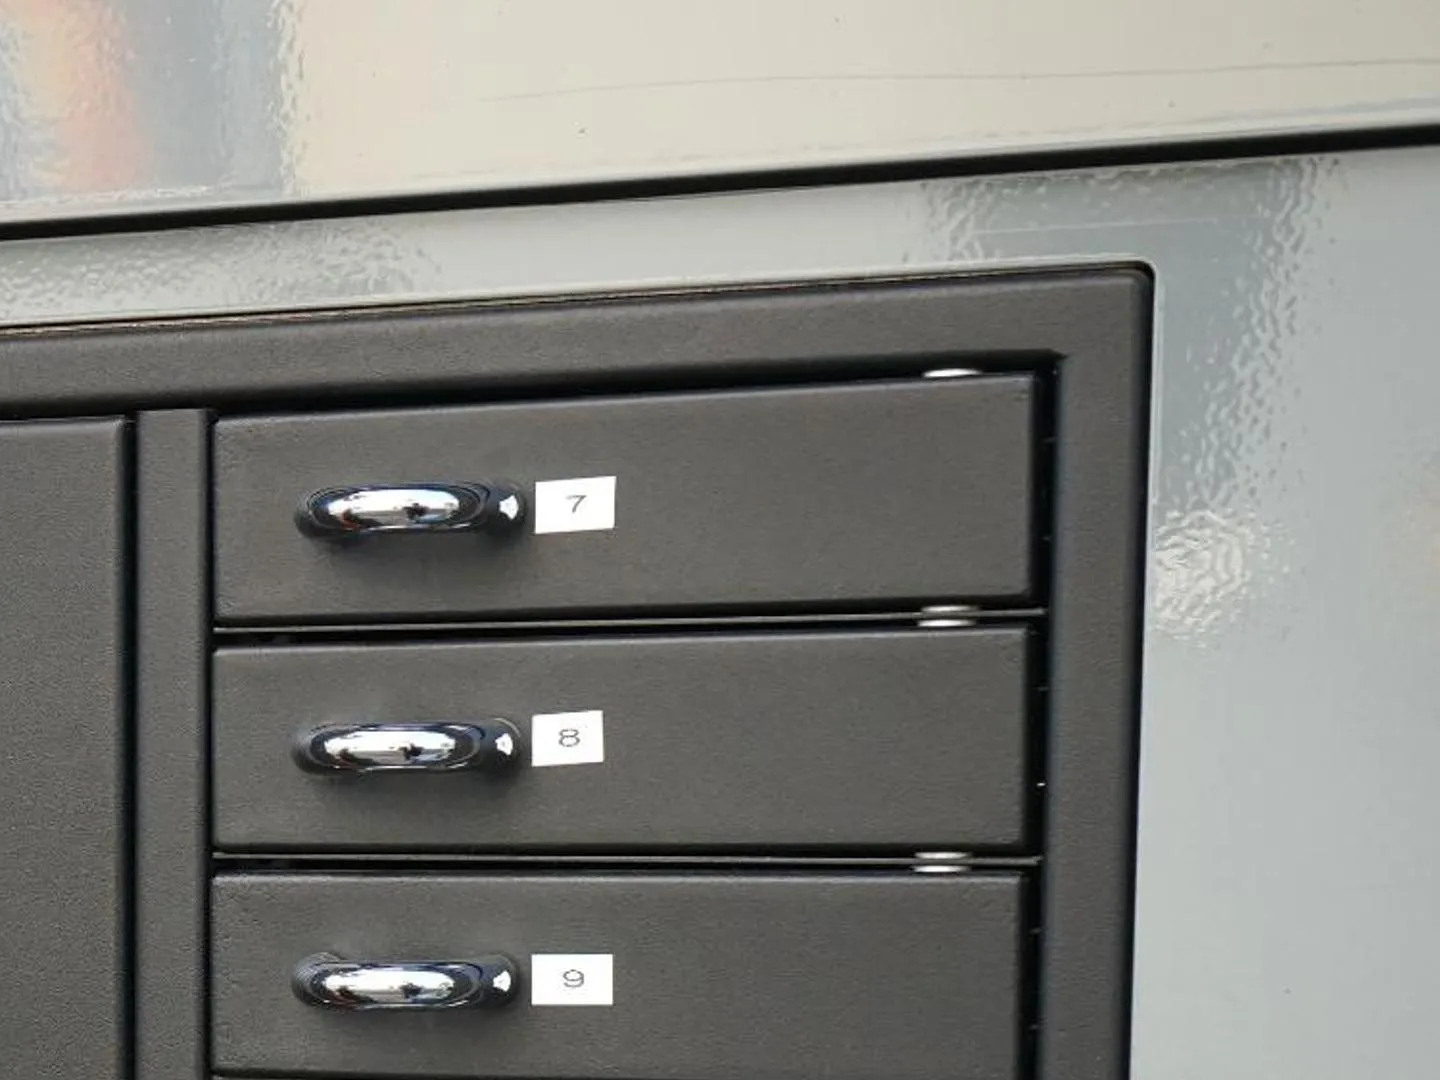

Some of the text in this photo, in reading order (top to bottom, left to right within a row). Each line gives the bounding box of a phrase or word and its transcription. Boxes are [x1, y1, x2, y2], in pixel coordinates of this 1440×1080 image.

[566, 494, 588, 514] 7
[558, 728, 580, 748] 8
[563, 968, 585, 989] 9
